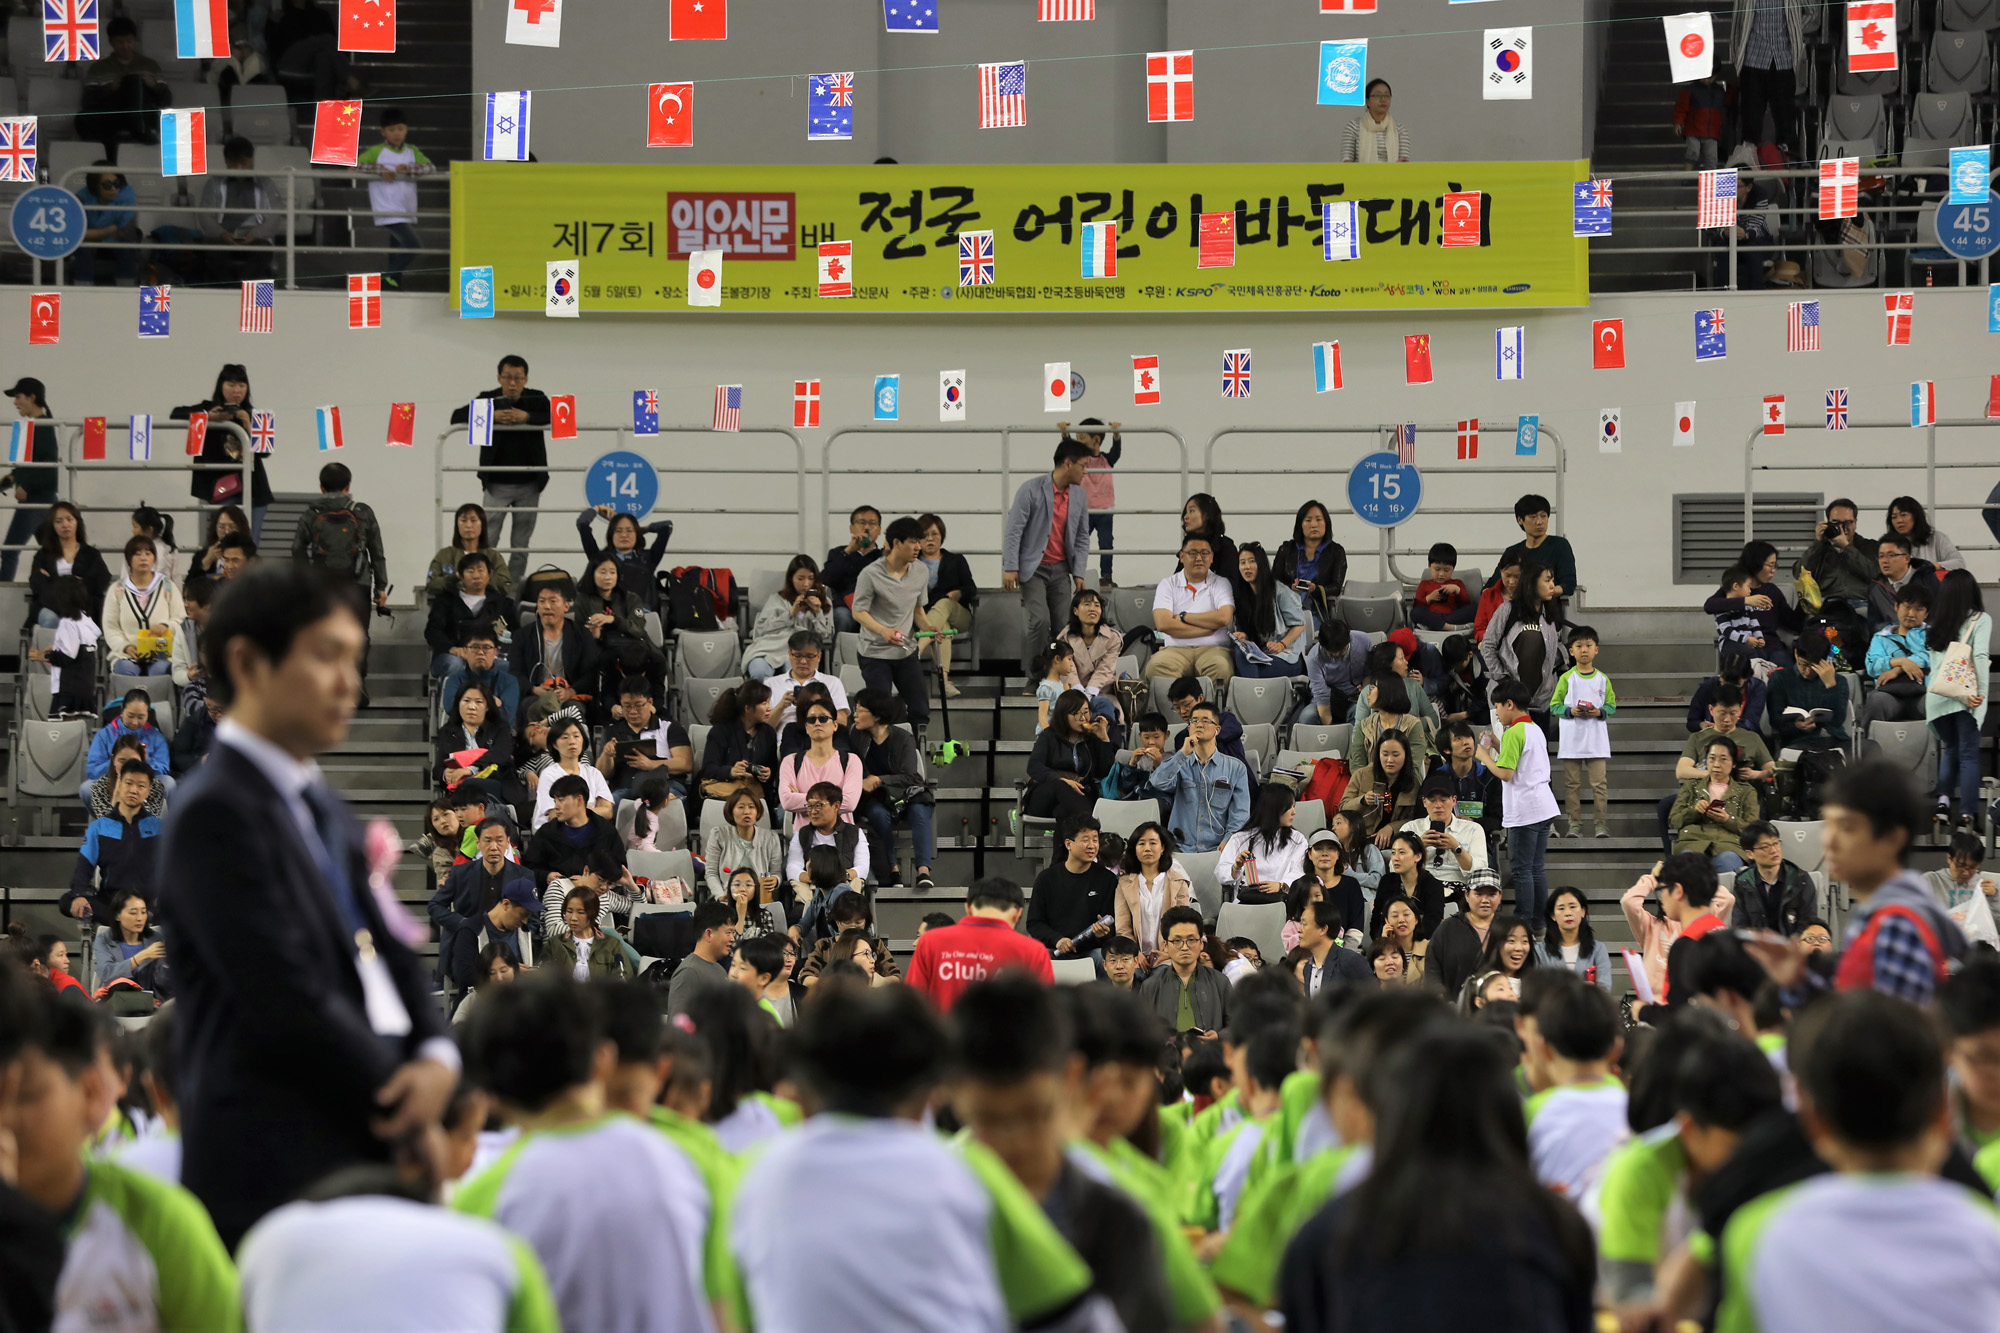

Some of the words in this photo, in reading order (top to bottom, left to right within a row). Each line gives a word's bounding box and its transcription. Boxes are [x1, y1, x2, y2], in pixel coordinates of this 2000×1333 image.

[29, 207, 67, 233] 43
[552, 220, 654, 257] 제7회
[671, 199, 789, 253] 일요신문
[801, 222, 836, 250] 배
[859, 187, 981, 259] 전국
[1953, 207, 1990, 233] 45
[1957, 237, 1968, 245] 44
[1975, 237, 1987, 245] 46
[584, 285, 600, 298] 5월
[606, 285, 642, 298] 5일(토)
[1176, 287, 1213, 297] KSPO
[606, 472, 639, 498] 14
[1368, 473, 1400, 500] 15
[626, 503, 637, 511] 15
[1369, 504, 1378, 512] 14
[1389, 504, 1399, 512] 16
[953, 950, 964, 958] One
[966, 952, 977, 960] and
[979, 952, 994, 962] Only
[939, 961, 987, 981] Club
